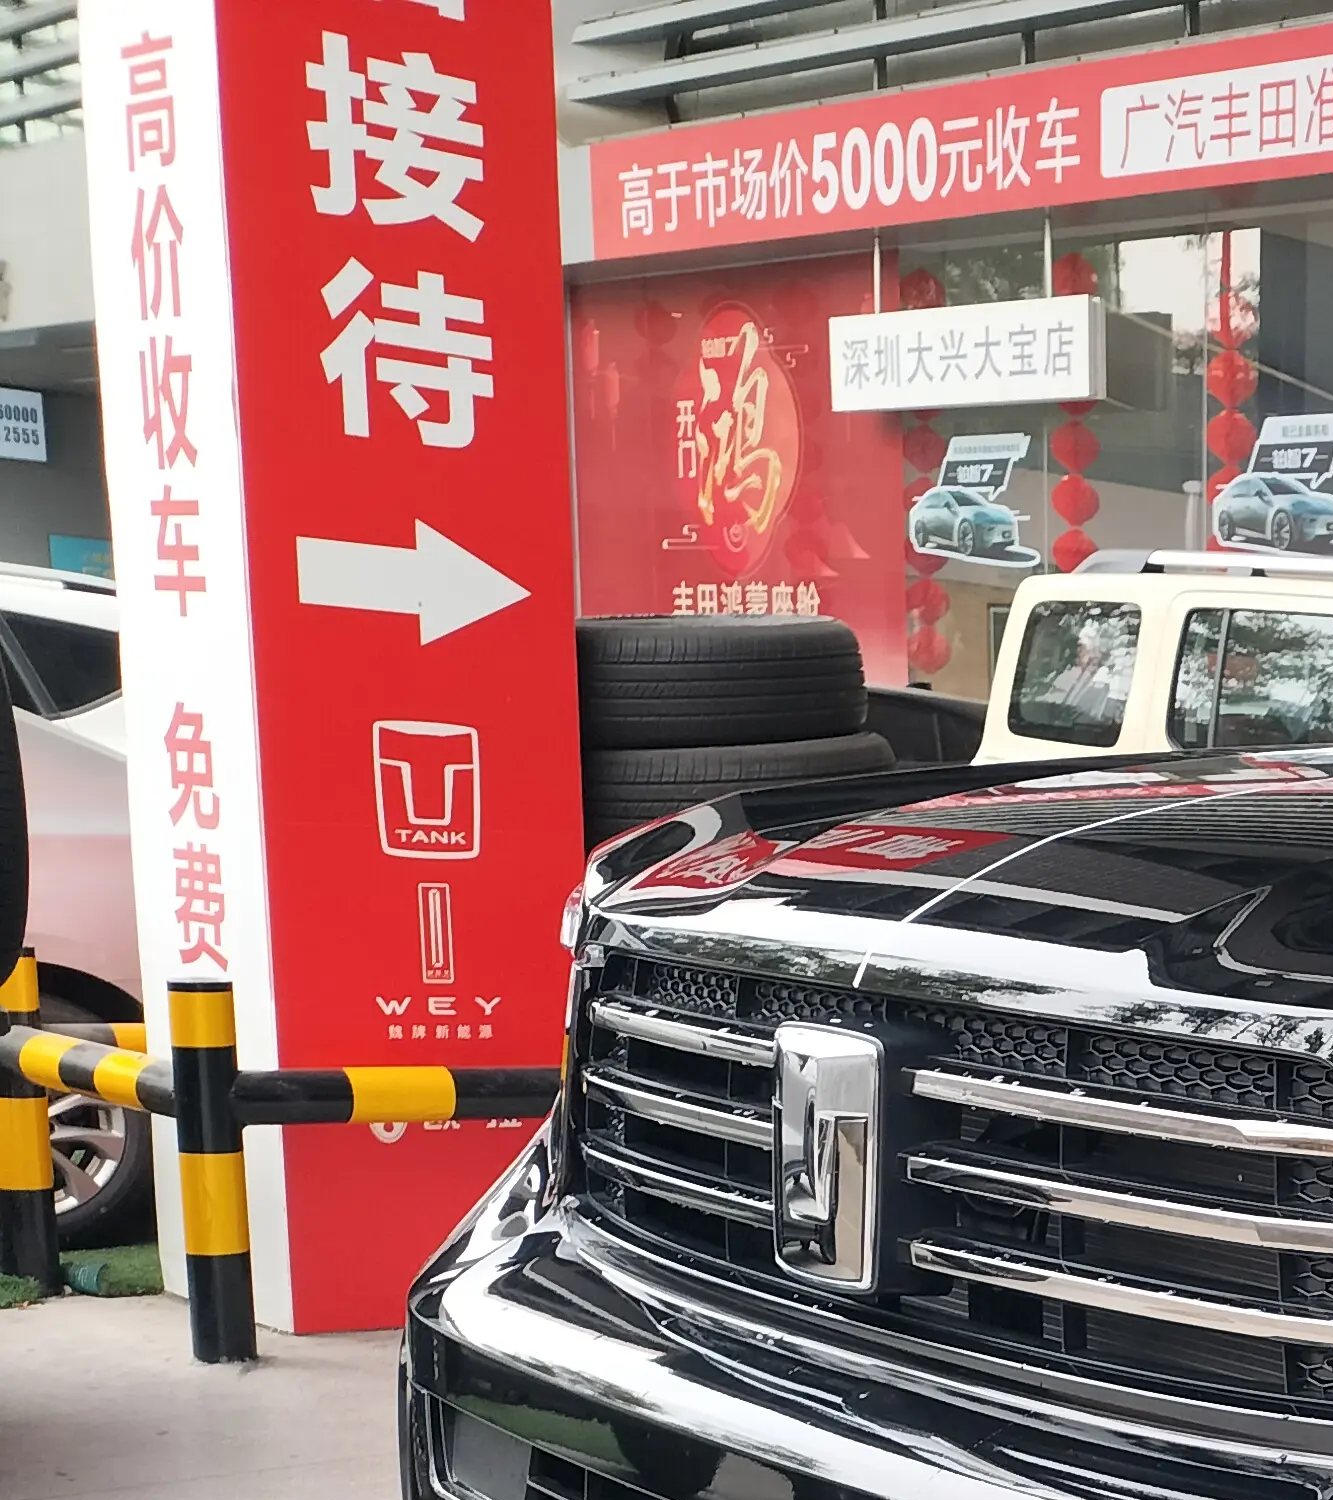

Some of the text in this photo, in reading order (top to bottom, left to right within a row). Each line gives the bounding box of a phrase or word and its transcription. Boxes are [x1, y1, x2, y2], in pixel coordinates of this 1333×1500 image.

[618, 97, 1080, 239] 高于市场价5000元收车
[305, 0, 494, 448] 接待
[842, 321, 1075, 389] 深圳大兴大宝店
[676, 400, 697, 478] 开门
[120, 31, 229, 973] 高价收车 免费
[672, 580, 821, 616] 丰田鸿蒙座舱
[394, 828, 467, 845] TANK
[375, 996, 502, 1016] WEY
